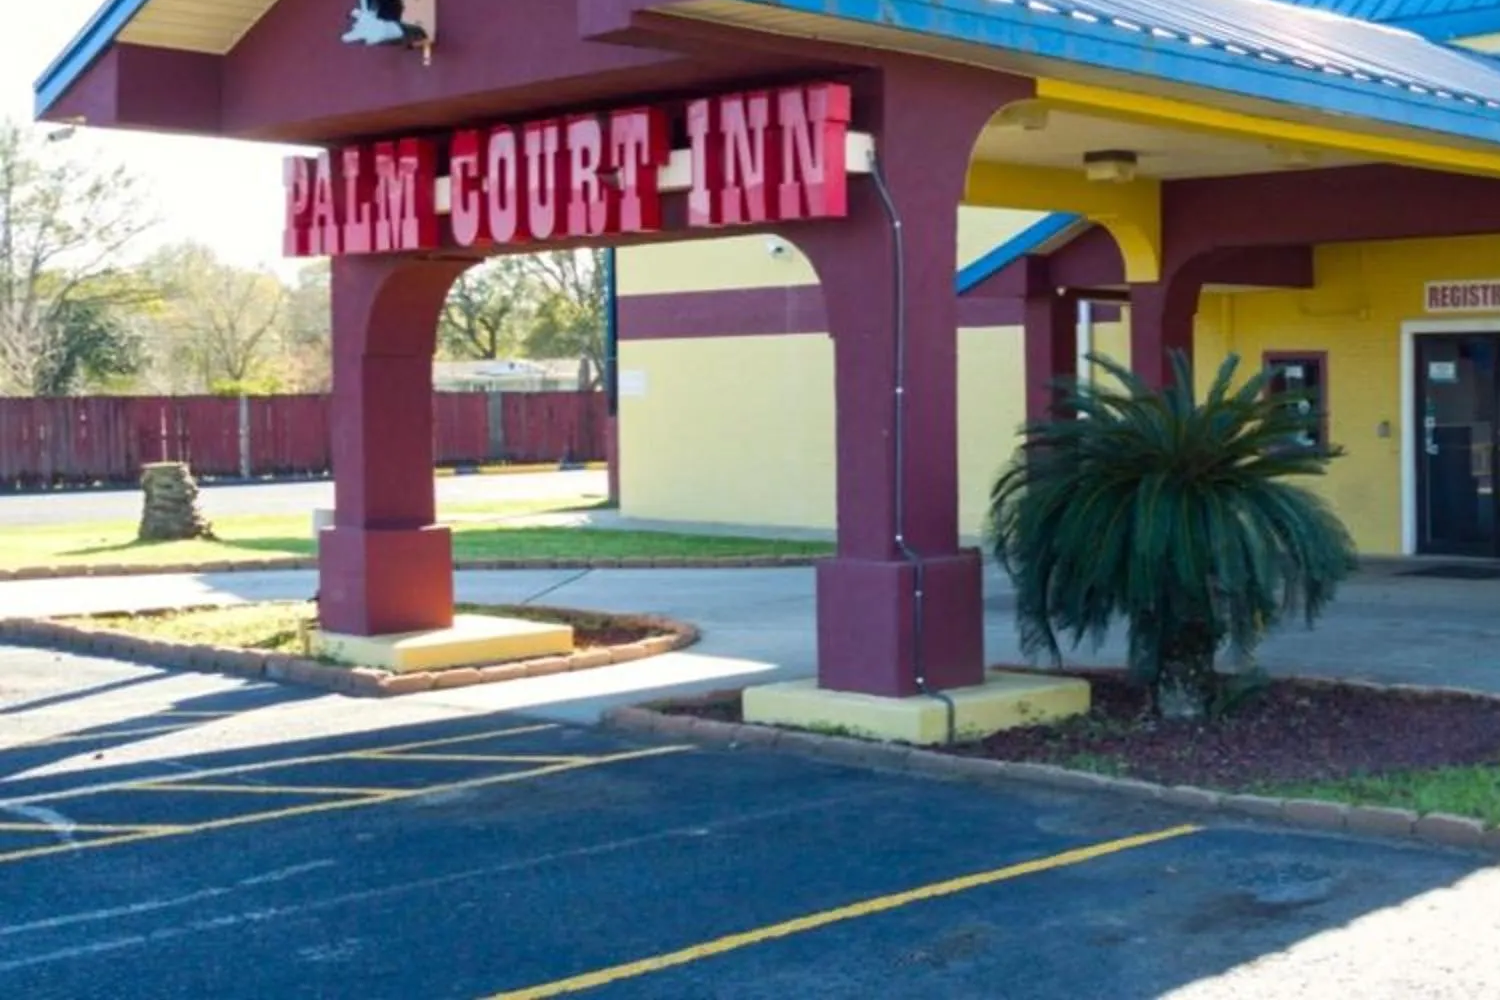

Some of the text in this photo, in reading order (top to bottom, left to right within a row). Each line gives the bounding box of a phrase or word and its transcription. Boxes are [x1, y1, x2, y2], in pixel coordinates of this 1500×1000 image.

[283, 85, 842, 257] PALM COURT INN
